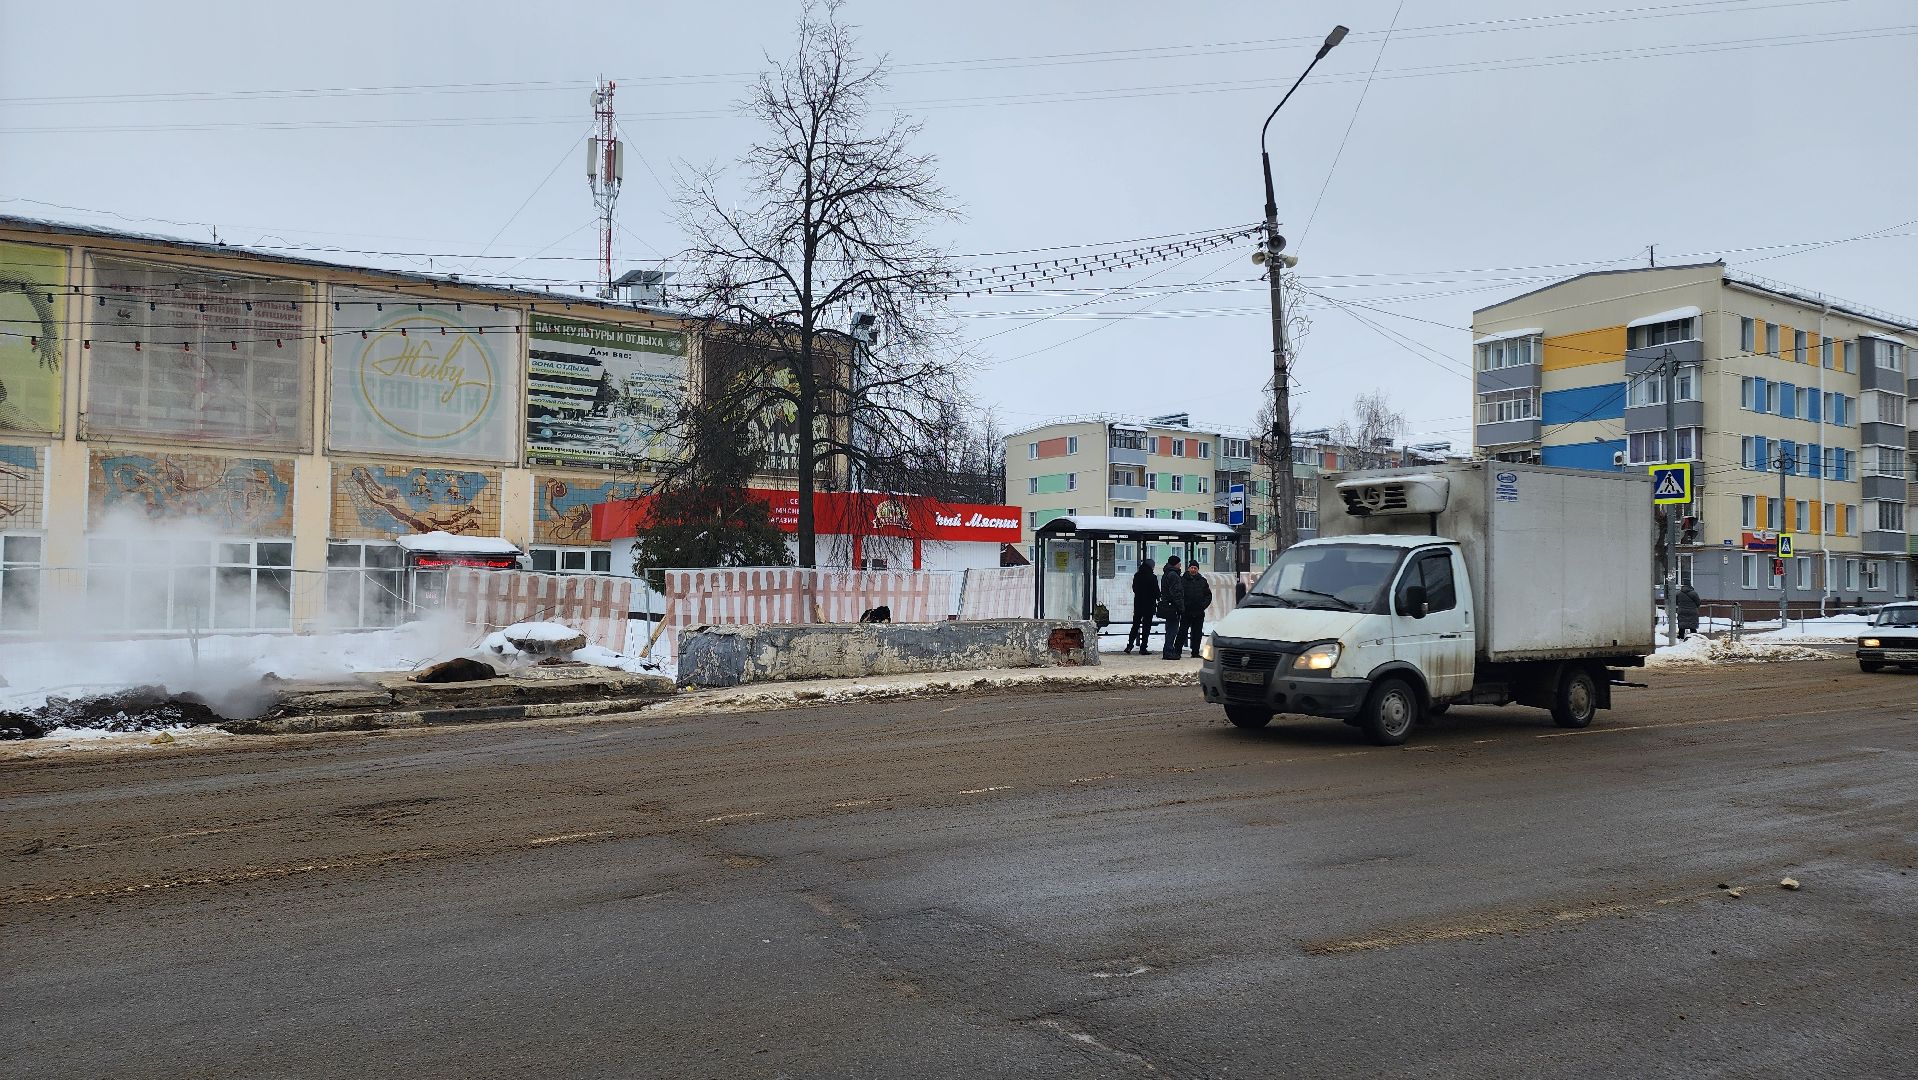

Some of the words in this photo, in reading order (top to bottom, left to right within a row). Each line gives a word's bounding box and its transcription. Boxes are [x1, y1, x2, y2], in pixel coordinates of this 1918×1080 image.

[535, 321, 561, 335] ПАРК
[563, 324, 615, 340] КУЛЬТУРЫ
[616, 332, 623, 342] И
[625, 333, 664, 347] ОТДЫХА
[589, 347, 608, 356] Для
[531, 361, 555, 369] ЗОНА
[556, 363, 590, 372] ОТДЫХА
[965, 512, 1019, 529] Мясник
